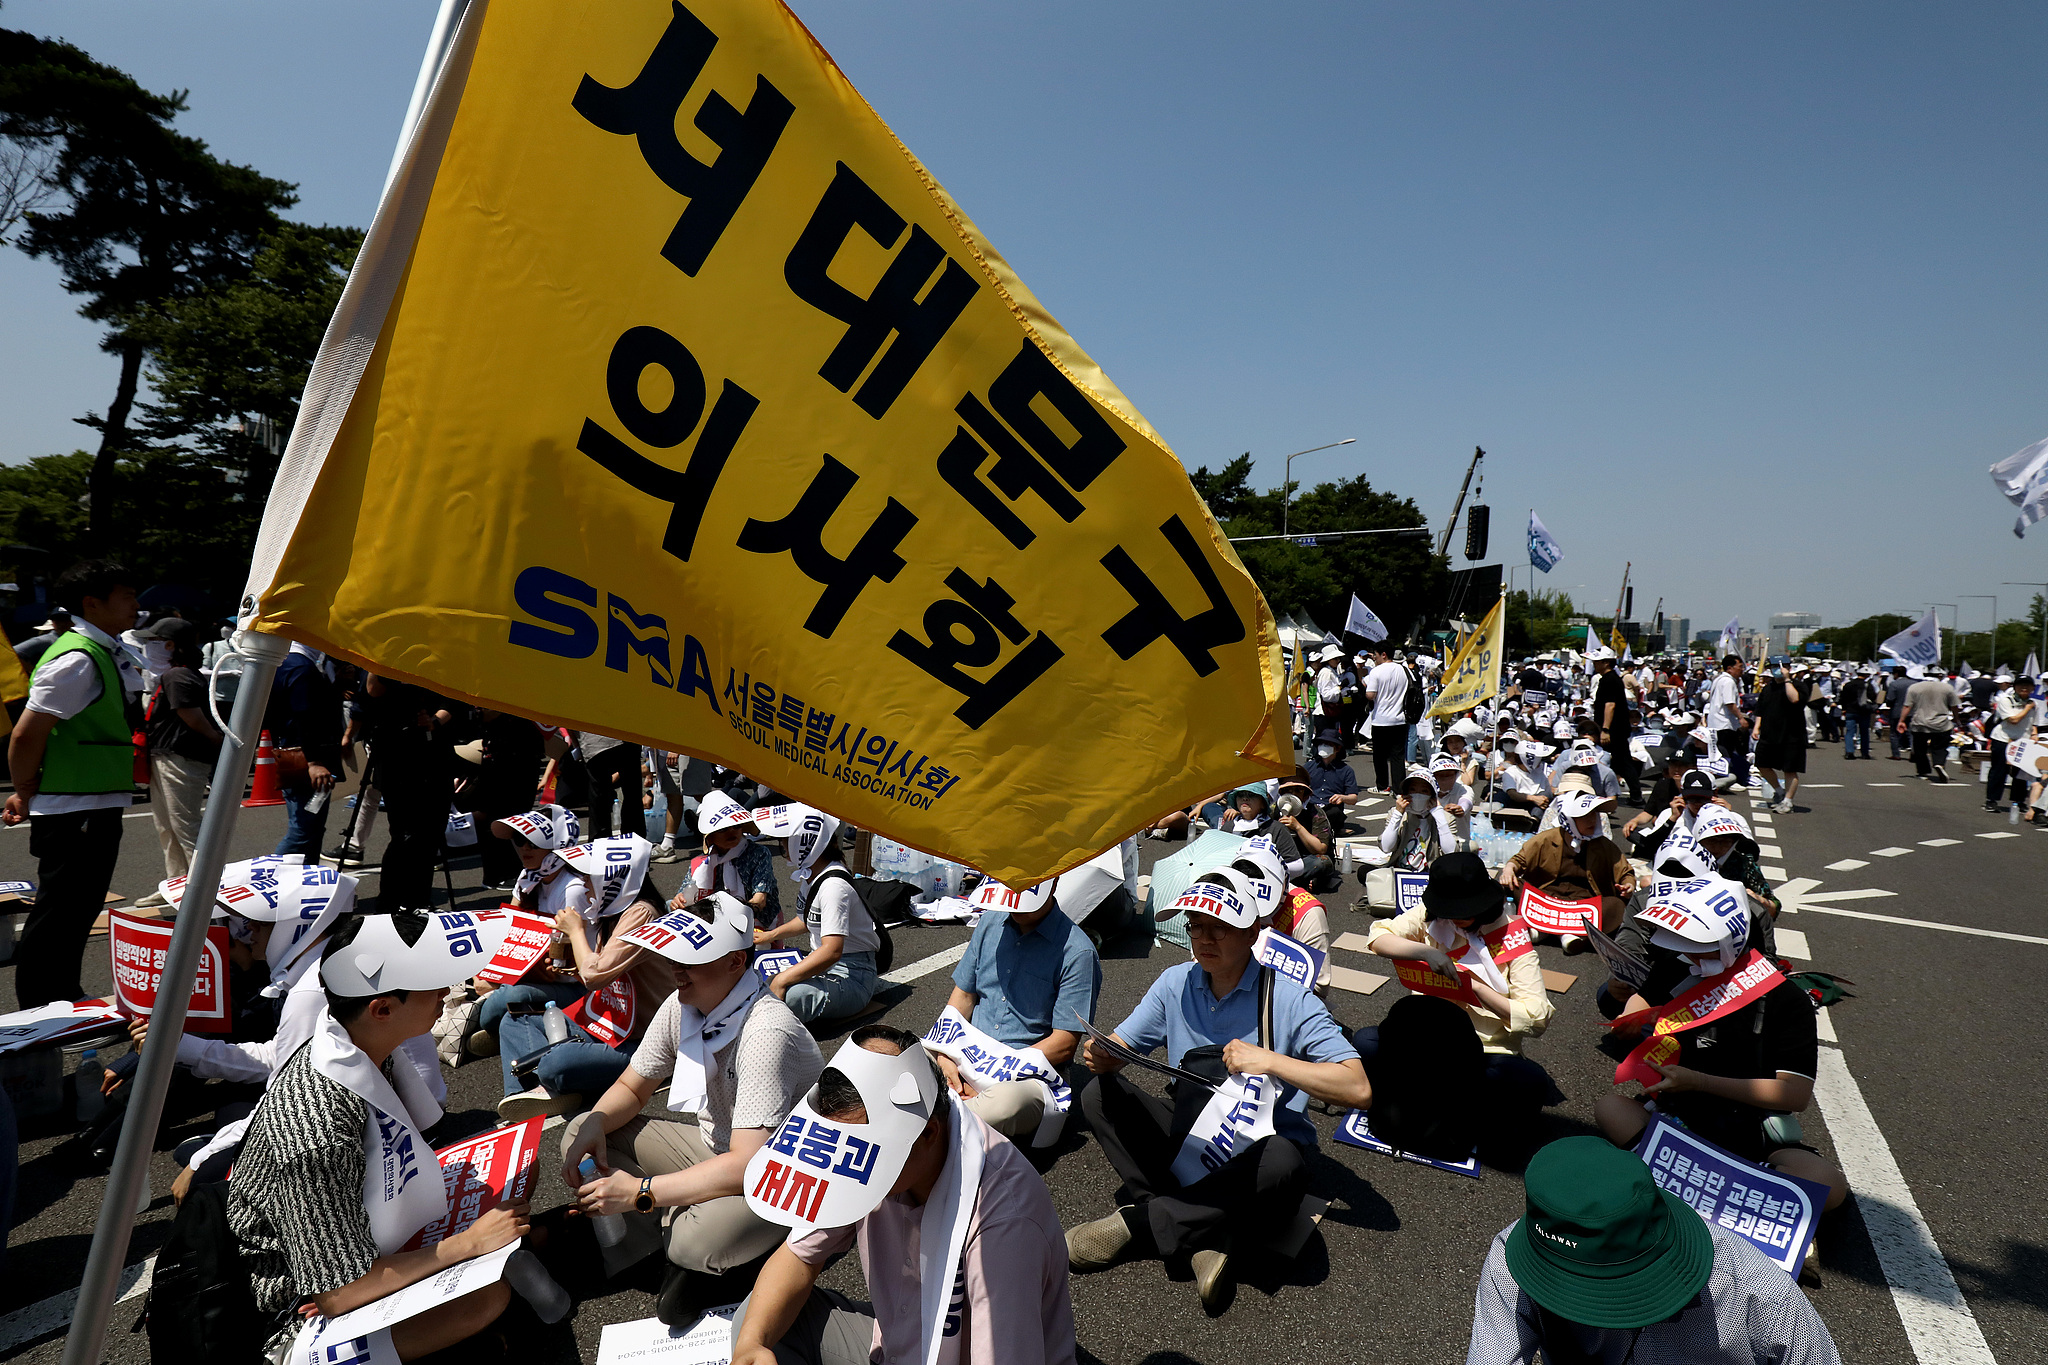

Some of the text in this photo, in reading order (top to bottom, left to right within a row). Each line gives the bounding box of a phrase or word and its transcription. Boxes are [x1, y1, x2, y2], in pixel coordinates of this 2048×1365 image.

[571, 0, 1246, 678] 서대문구
[576, 325, 1065, 730] 의사회
[508, 566, 723, 717] SMA
[724, 667, 960, 800] 서울특별시의사회
[729, 712, 934, 811] SEOUL MEDICAL ASSOCIATION
[1175, 896, 1223, 916] 저지
[1641, 906, 1689, 931] 저지
[115, 939, 150, 968] 일방적인
[1260, 946, 1308, 980] 교육농단
[116, 961, 150, 993] 국민건강
[1690, 981, 1744, 1018] 확대추진
[463, 1139, 498, 1192] 훼손된다
[765, 1114, 881, 1186] 료붕괴
[387, 1158, 395, 1201] 대한의사협회
[752, 1159, 829, 1223] 저지
[1655, 1146, 1800, 1224] 의료농단 교육농단
[1535, 1223, 1578, 1249] CALLAWAY
[1718, 1205, 1792, 1249] 붕괴된다
[617, 1339, 706, 1360] 228-910015-16204
